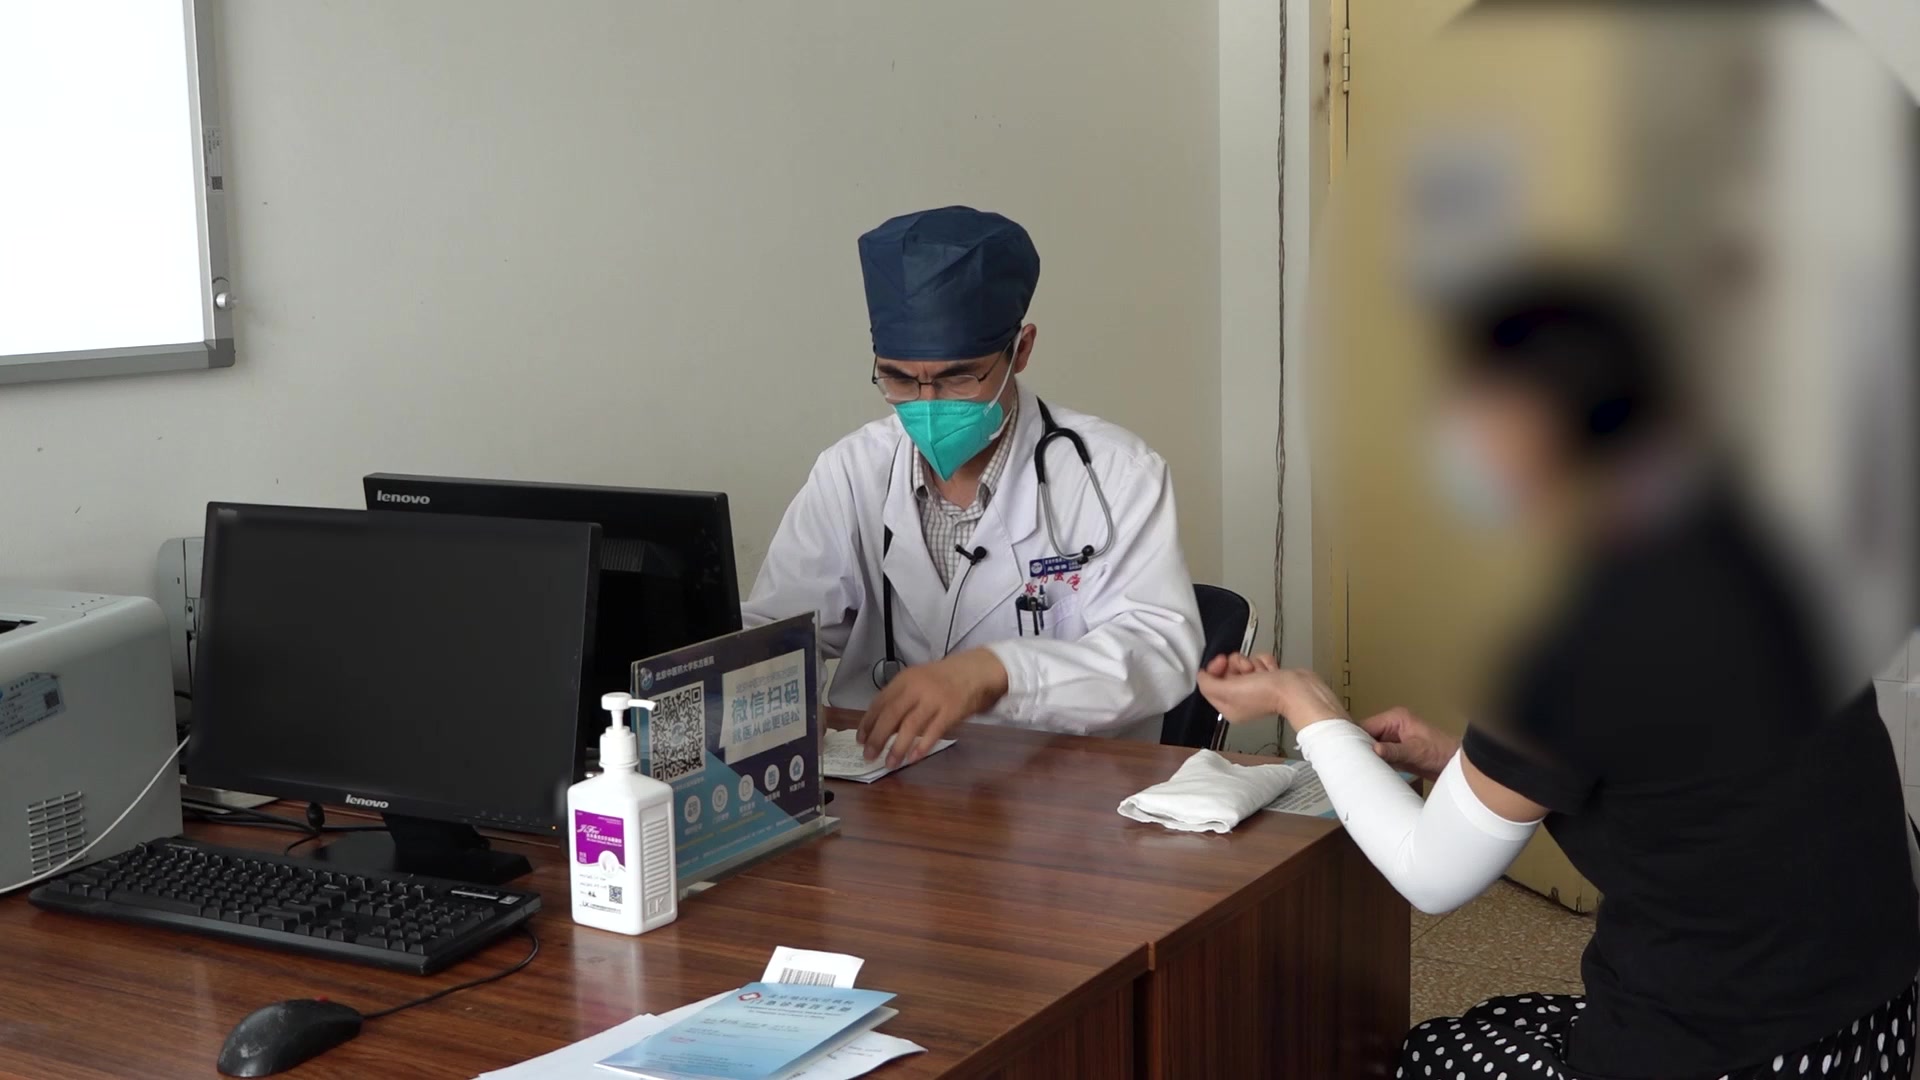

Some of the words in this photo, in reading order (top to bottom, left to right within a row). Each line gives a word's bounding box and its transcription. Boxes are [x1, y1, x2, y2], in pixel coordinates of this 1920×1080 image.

[377, 490, 431, 504] lenovo
[731, 679, 800, 724] 微信扫码
[345, 794, 389, 808] lenovo
